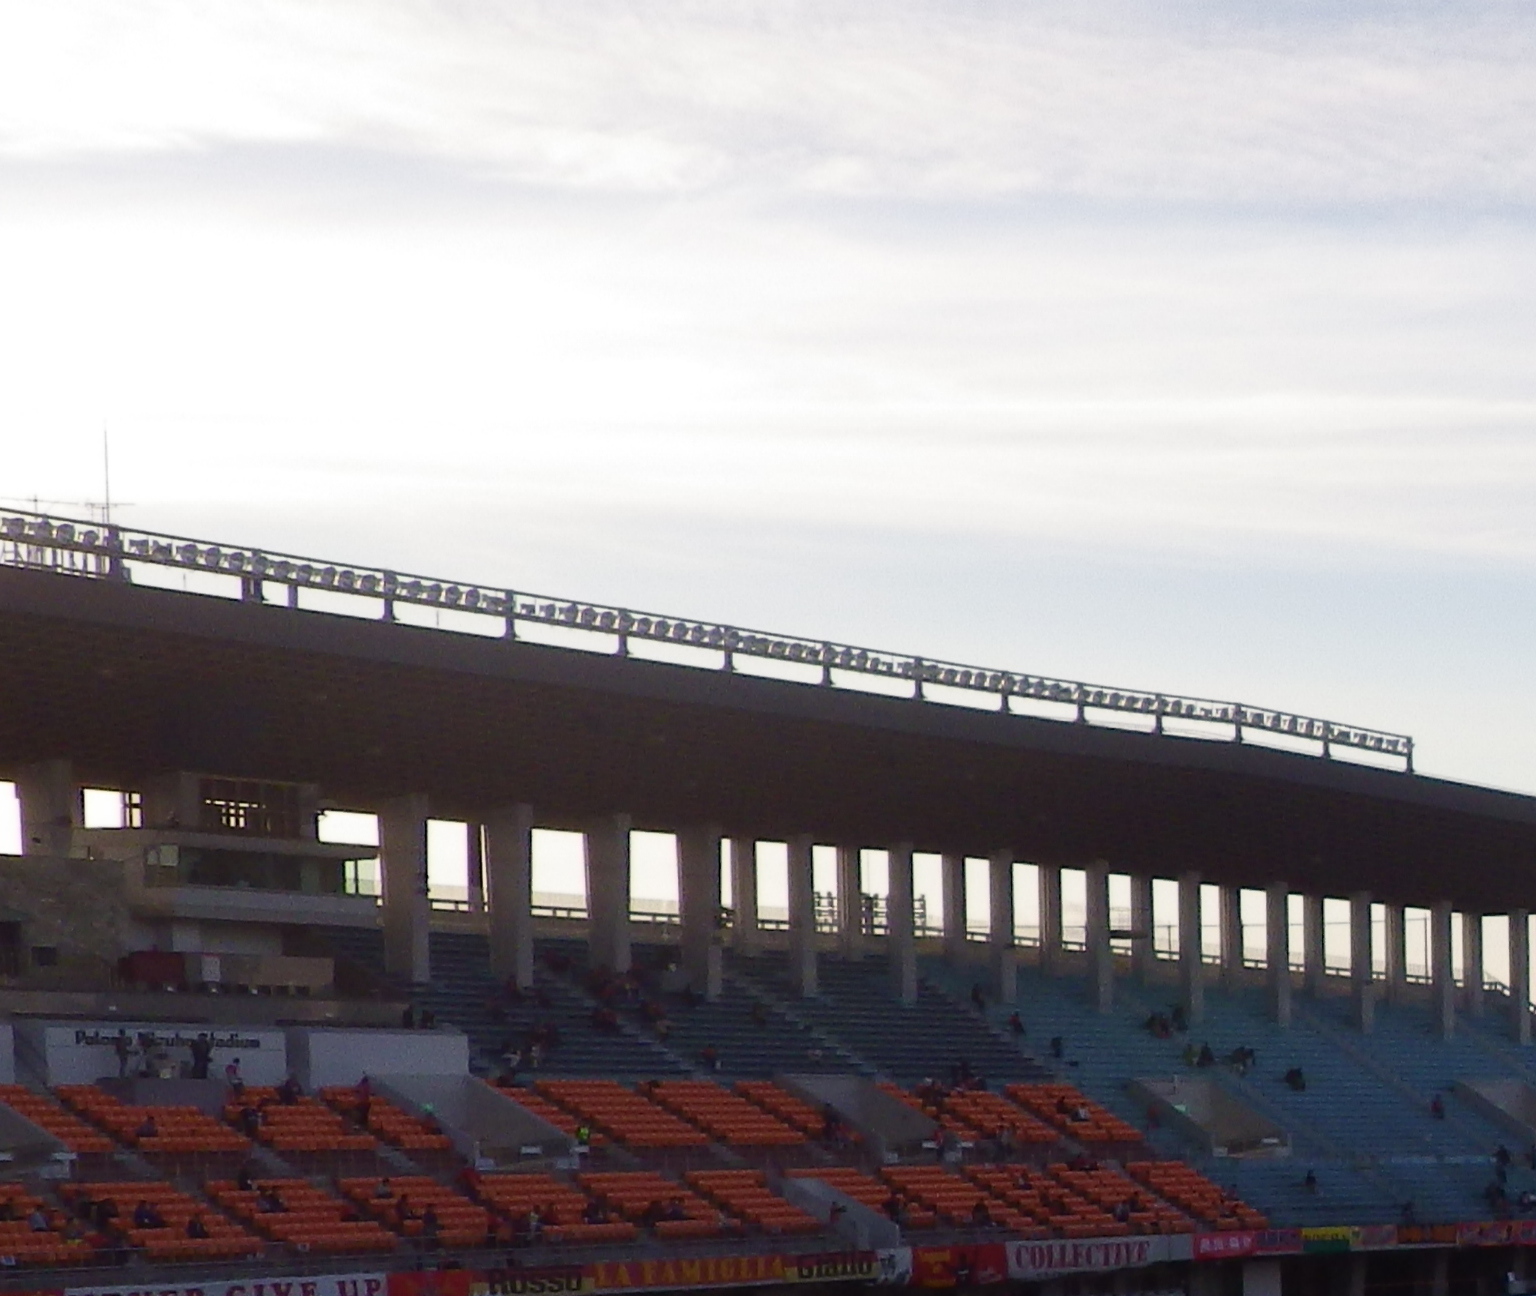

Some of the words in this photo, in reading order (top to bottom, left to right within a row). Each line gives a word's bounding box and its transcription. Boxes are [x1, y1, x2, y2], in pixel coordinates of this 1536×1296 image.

[1015, 1240, 1150, 1270] COLLECTIVE
[594, 1260, 631, 1288] LA
[641, 1255, 787, 1286] FAMIGLIA
